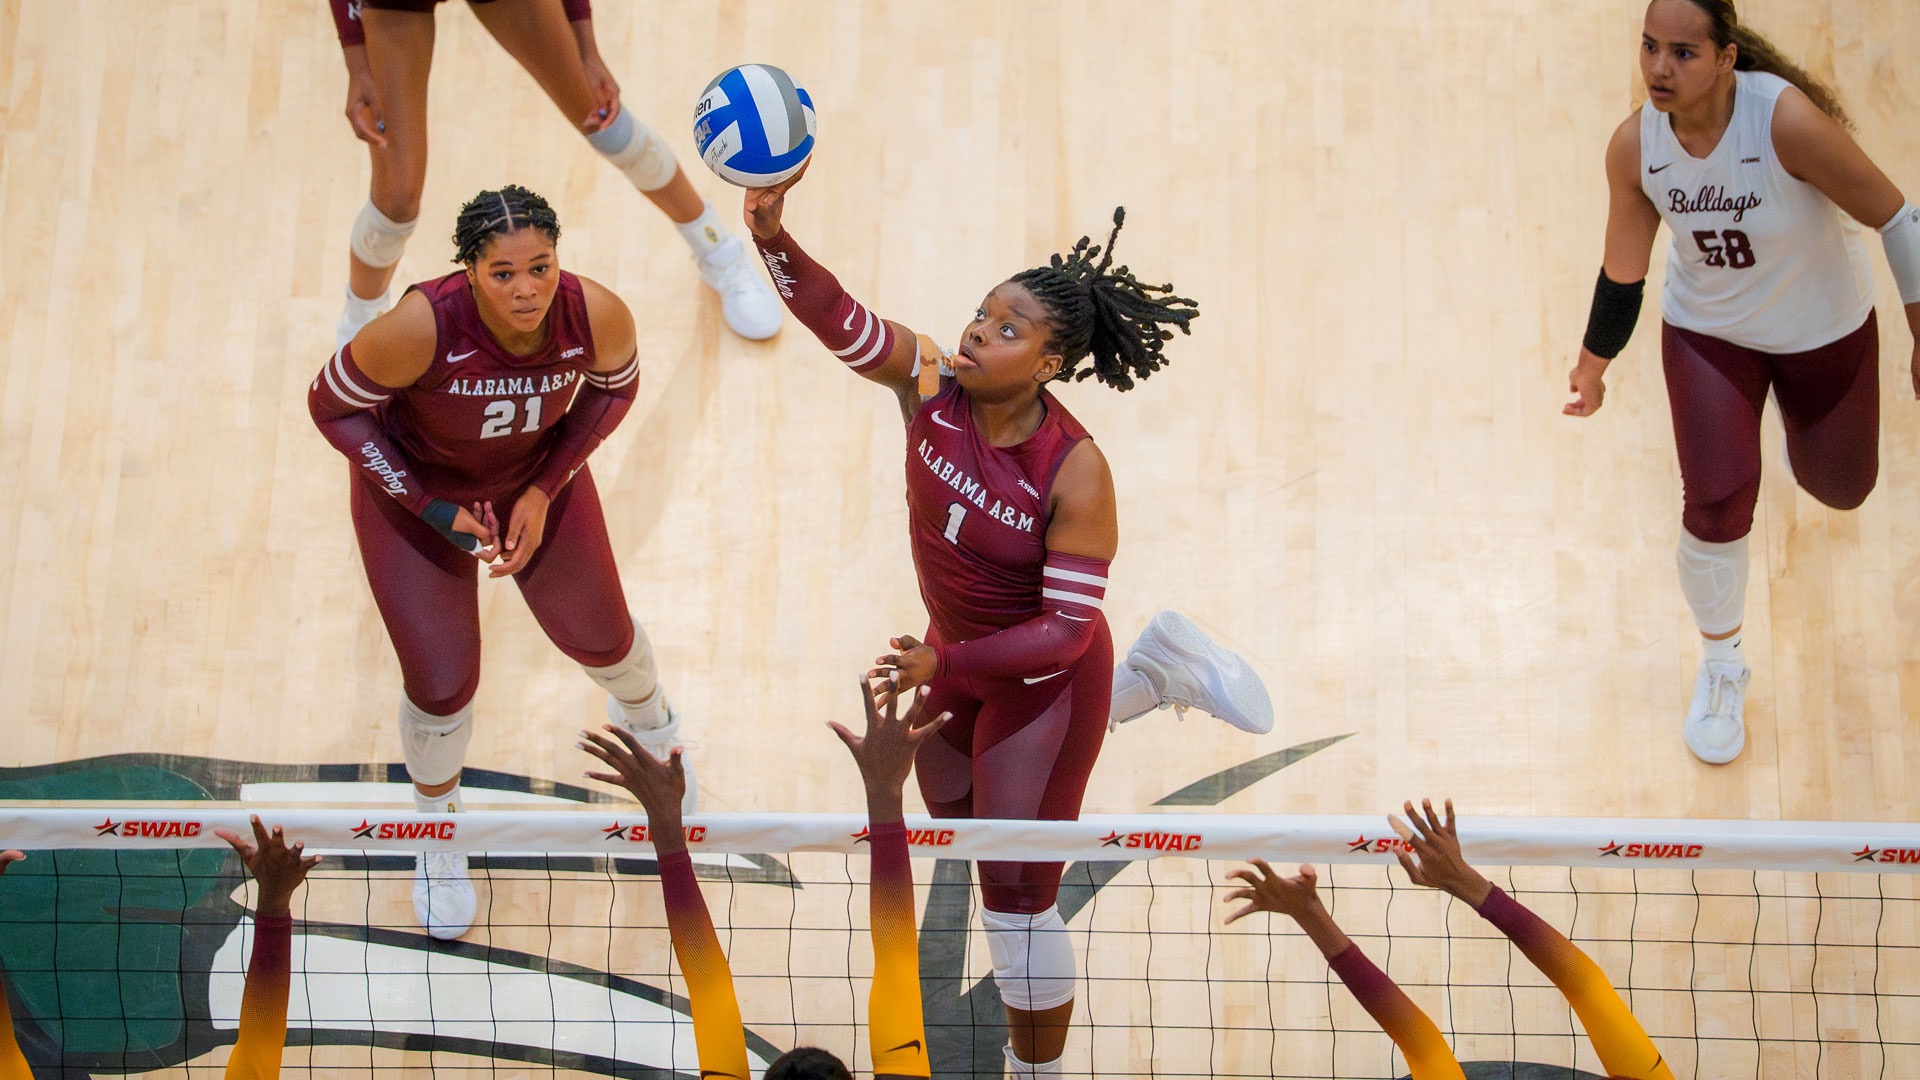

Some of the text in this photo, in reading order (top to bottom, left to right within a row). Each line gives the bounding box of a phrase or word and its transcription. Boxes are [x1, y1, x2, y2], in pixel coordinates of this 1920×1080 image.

[1668, 185, 1762, 223] Bulldogs
[1691, 229, 1756, 269] 58
[760, 248, 797, 299] Together
[447, 369, 577, 397] ALABAMA A&M
[480, 396, 542, 439] 21
[361, 441, 408, 498] Together
[917, 438, 1035, 533] ALABAMA A&M
[943, 501, 968, 546] 1
[122, 821, 202, 838] SWAC
[377, 821, 456, 841] SWAC
[629, 825, 706, 842] SC
[906, 829, 955, 846] WAC
[1125, 832, 1202, 852] SWAC
[1624, 843, 1703, 859] SWAC
